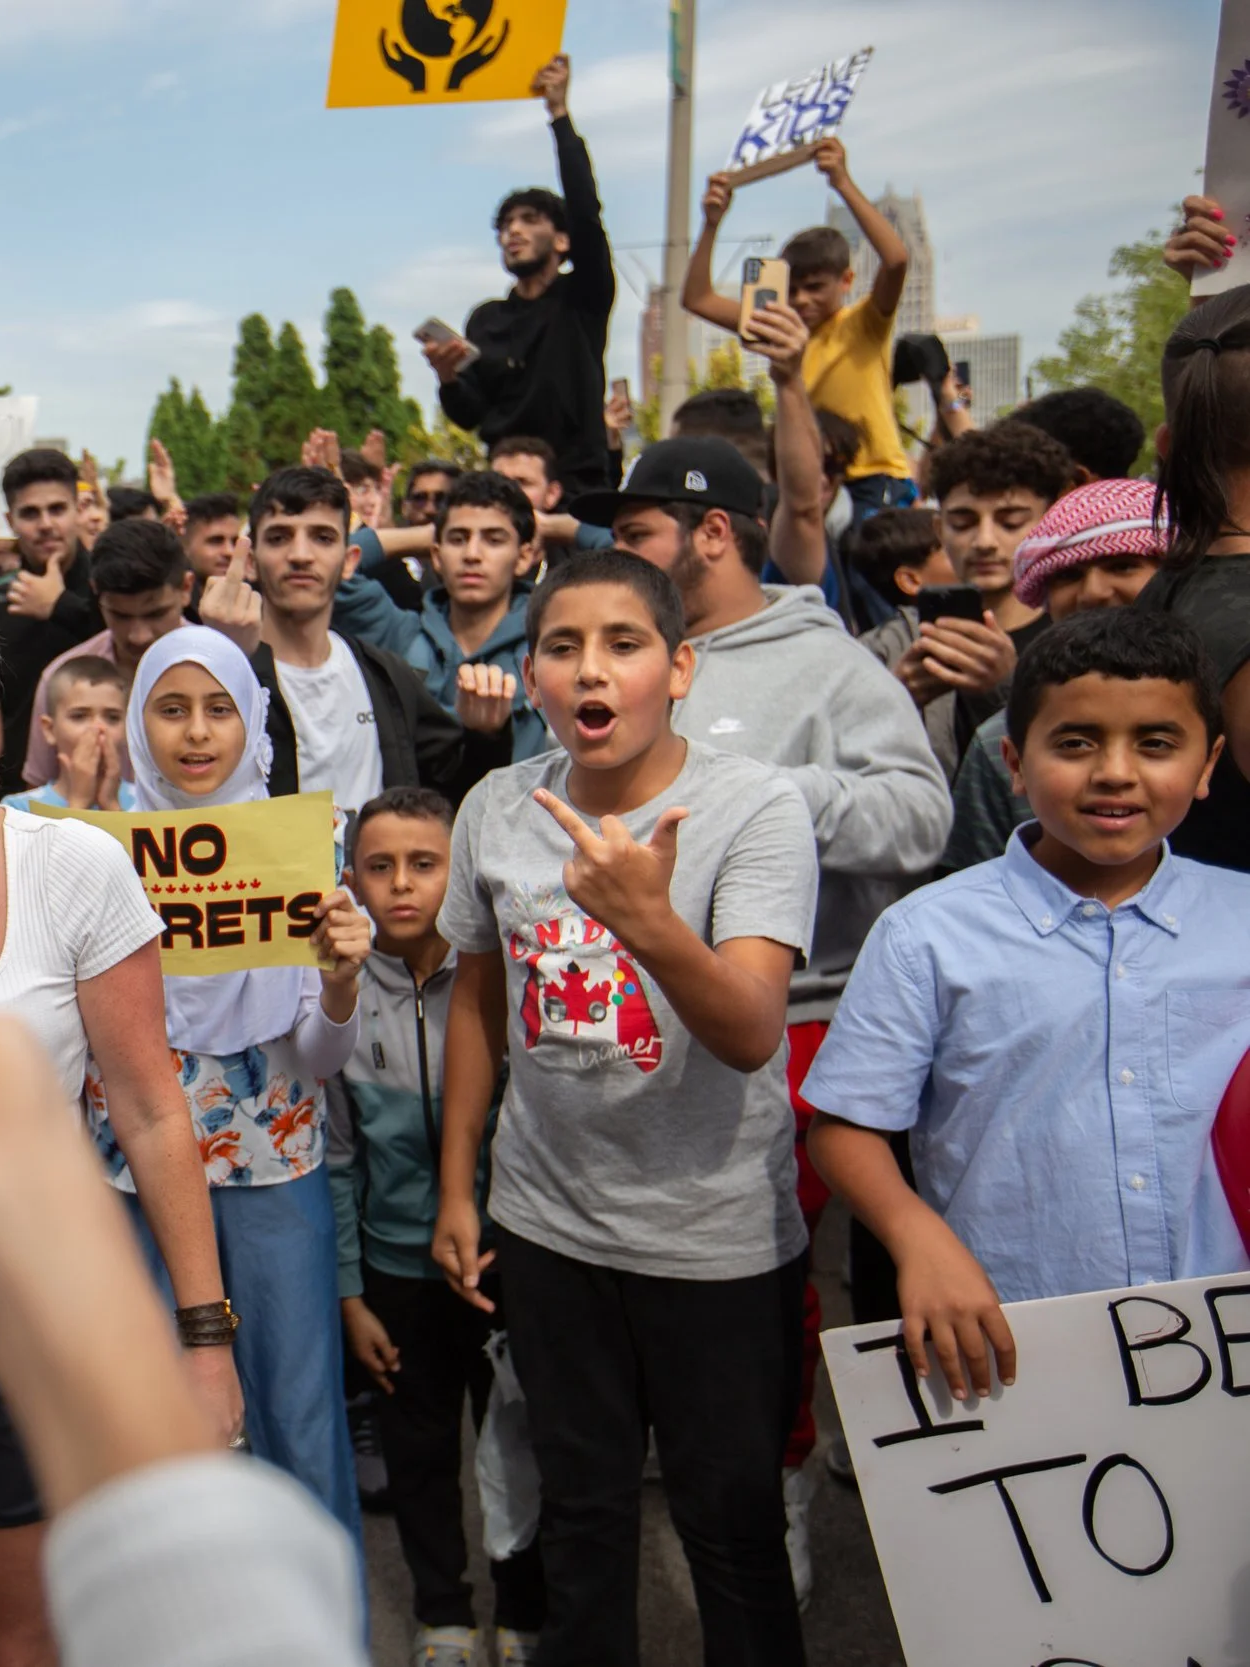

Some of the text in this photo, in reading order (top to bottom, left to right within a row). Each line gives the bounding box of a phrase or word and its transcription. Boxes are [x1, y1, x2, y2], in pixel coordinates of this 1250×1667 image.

[131, 823, 227, 878] NO
[151, 891, 324, 950] RETS
[926, 1452, 1175, 1603] TO
